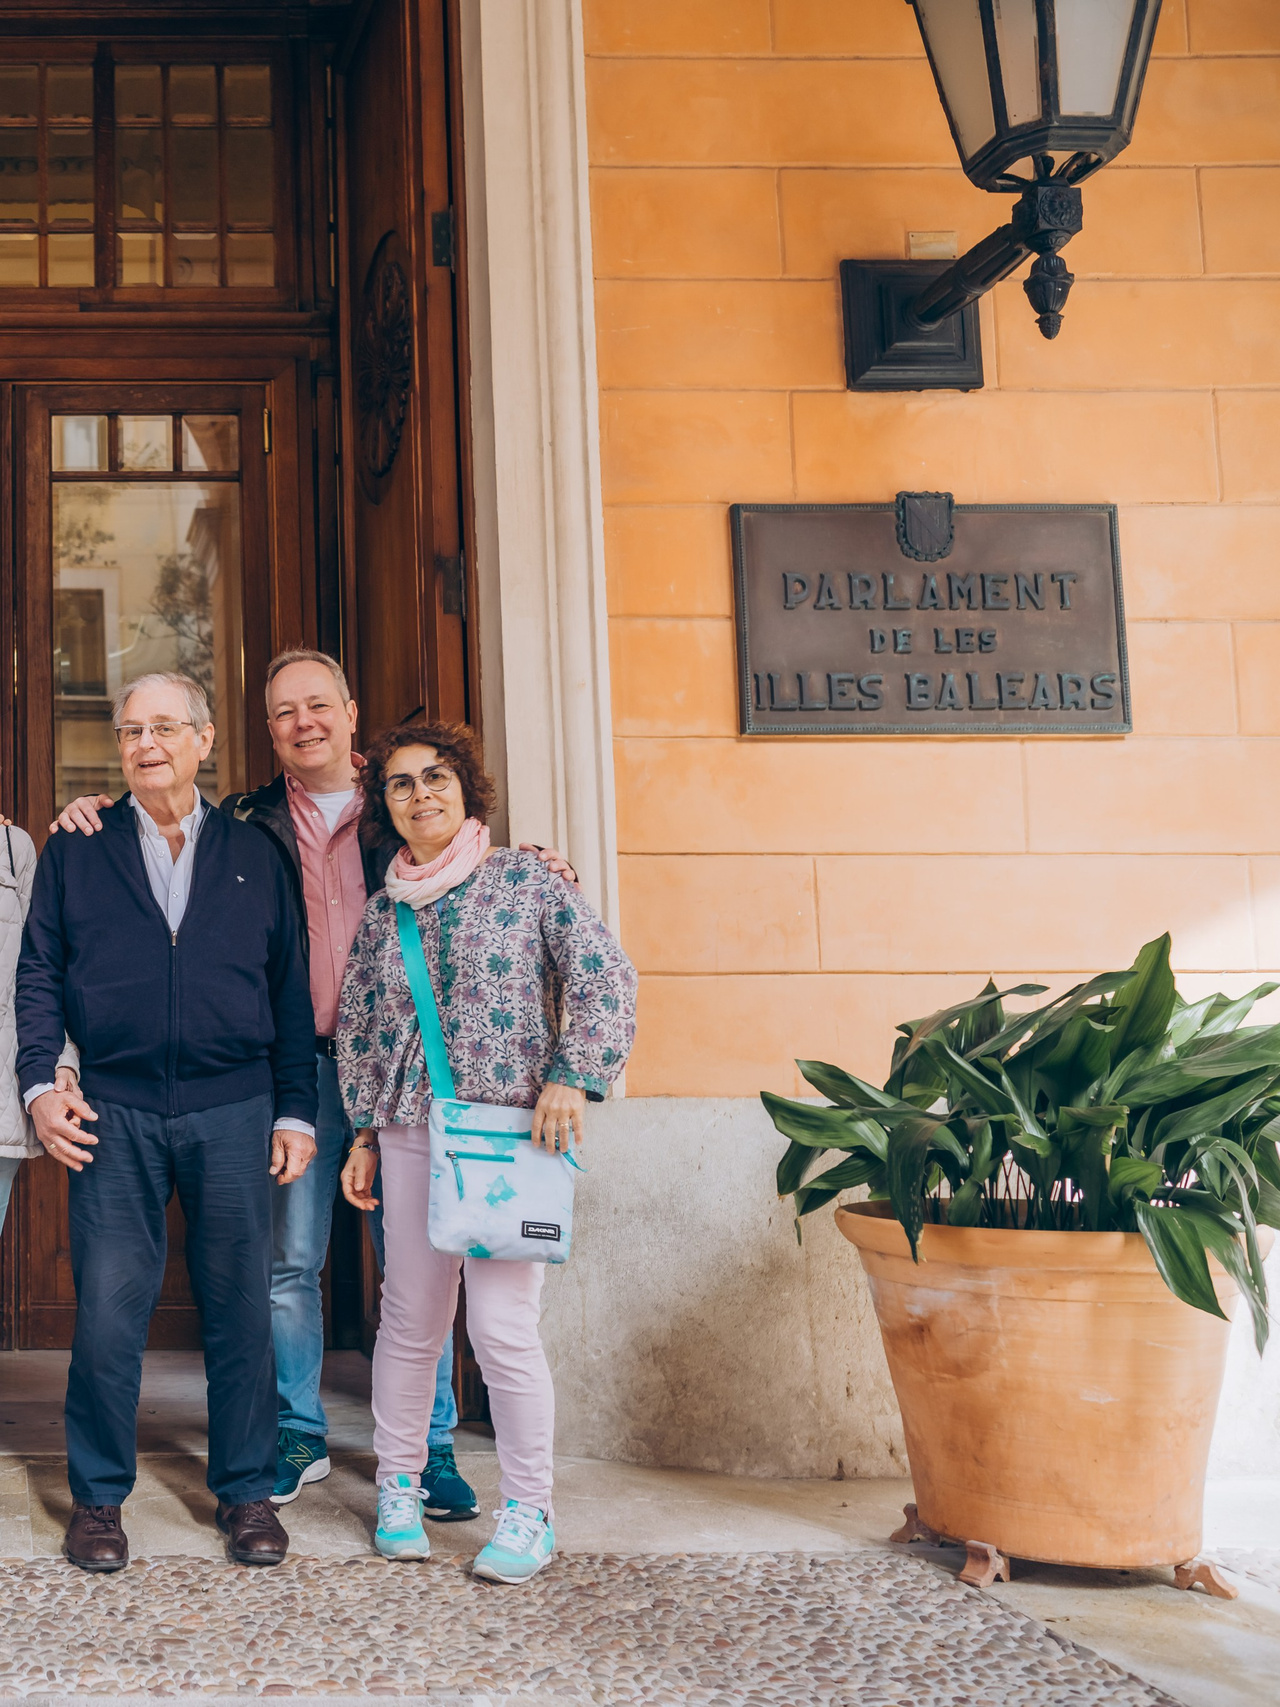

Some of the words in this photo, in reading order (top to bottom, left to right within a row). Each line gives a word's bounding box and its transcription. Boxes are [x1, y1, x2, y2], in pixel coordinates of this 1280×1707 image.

[781, 571, 1078, 611] PARLAMENT
[869, 628, 913, 655] DE
[933, 627, 998, 655] LES
[753, 672, 885, 712] ILLES
[904, 672, 1118, 711] BALEARS
